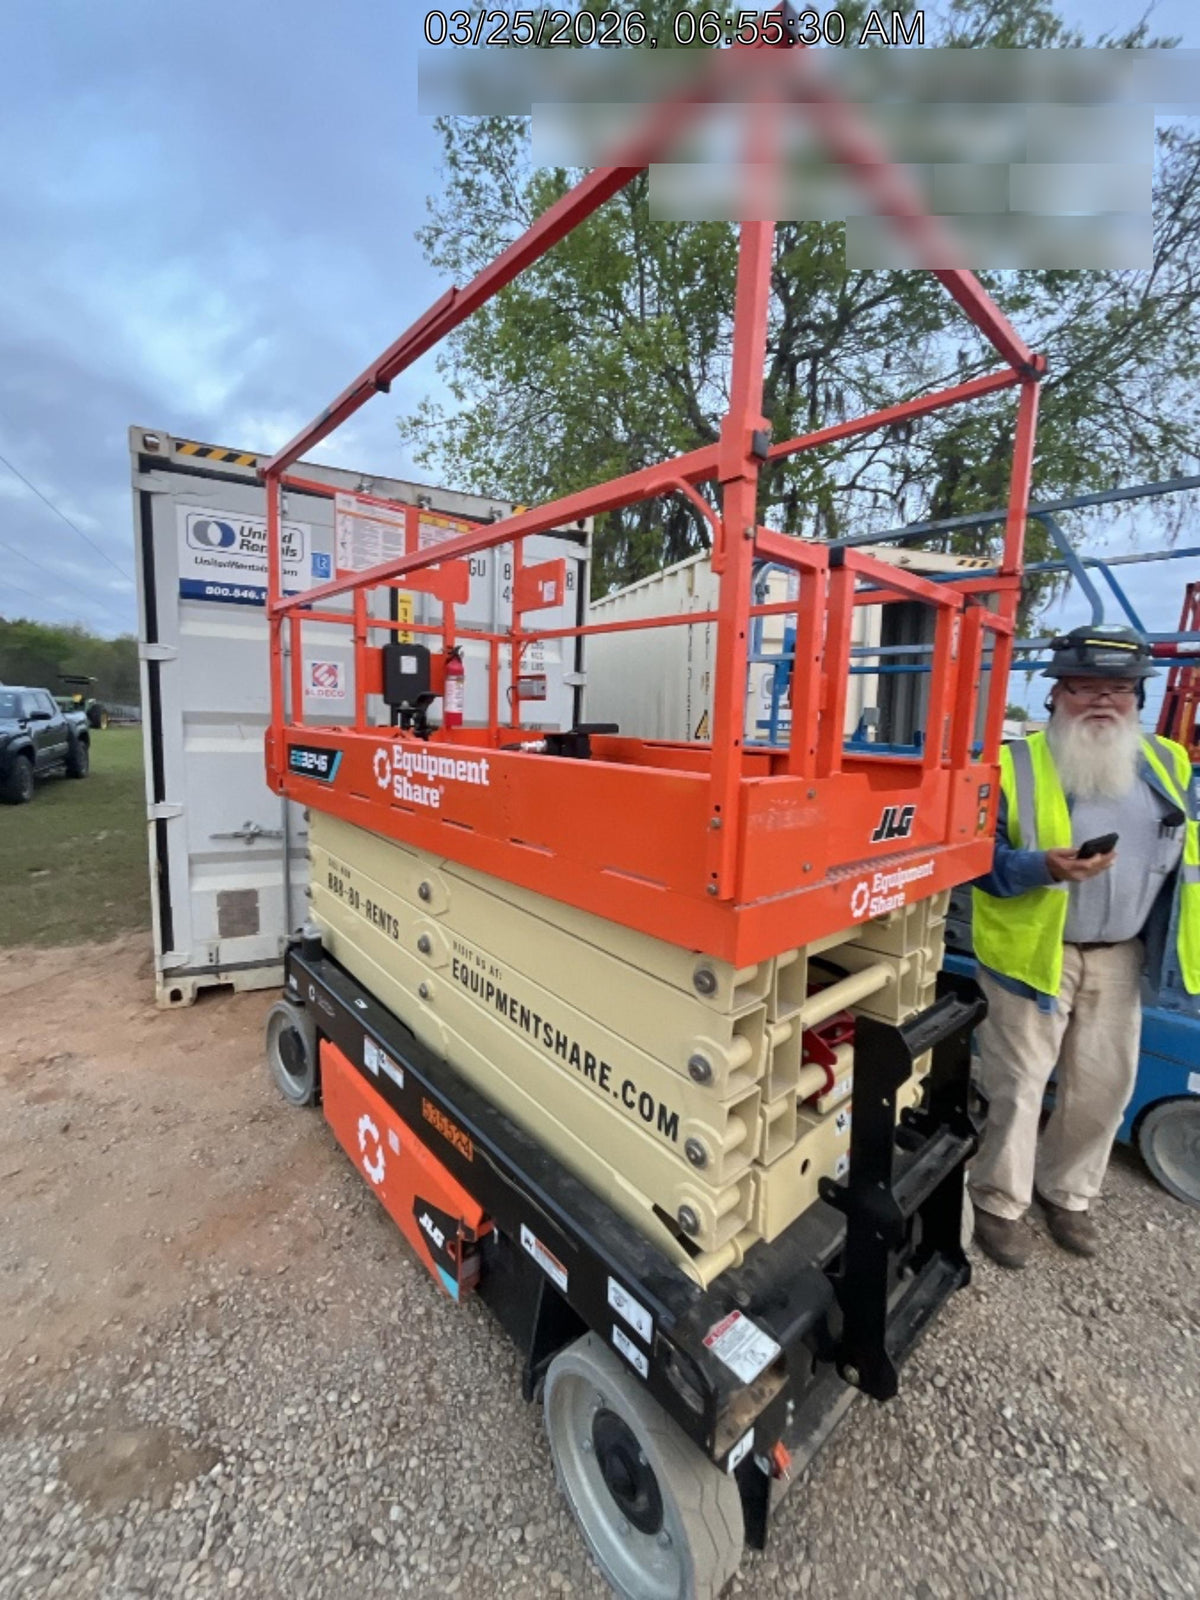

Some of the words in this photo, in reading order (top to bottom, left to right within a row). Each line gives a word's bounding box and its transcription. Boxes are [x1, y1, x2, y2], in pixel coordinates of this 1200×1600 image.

[240, 525, 293, 545] Unid
[392, 744, 490, 787] Equipment
[393, 774, 440, 809] Share
[869, 804, 917, 844] JLG
[871, 858, 935, 895] Equipment
[868, 892, 906, 919] Share
[452, 957, 681, 1143] EQUIPMENTSHARE.COM
[418, 1211, 446, 1250] JLG
